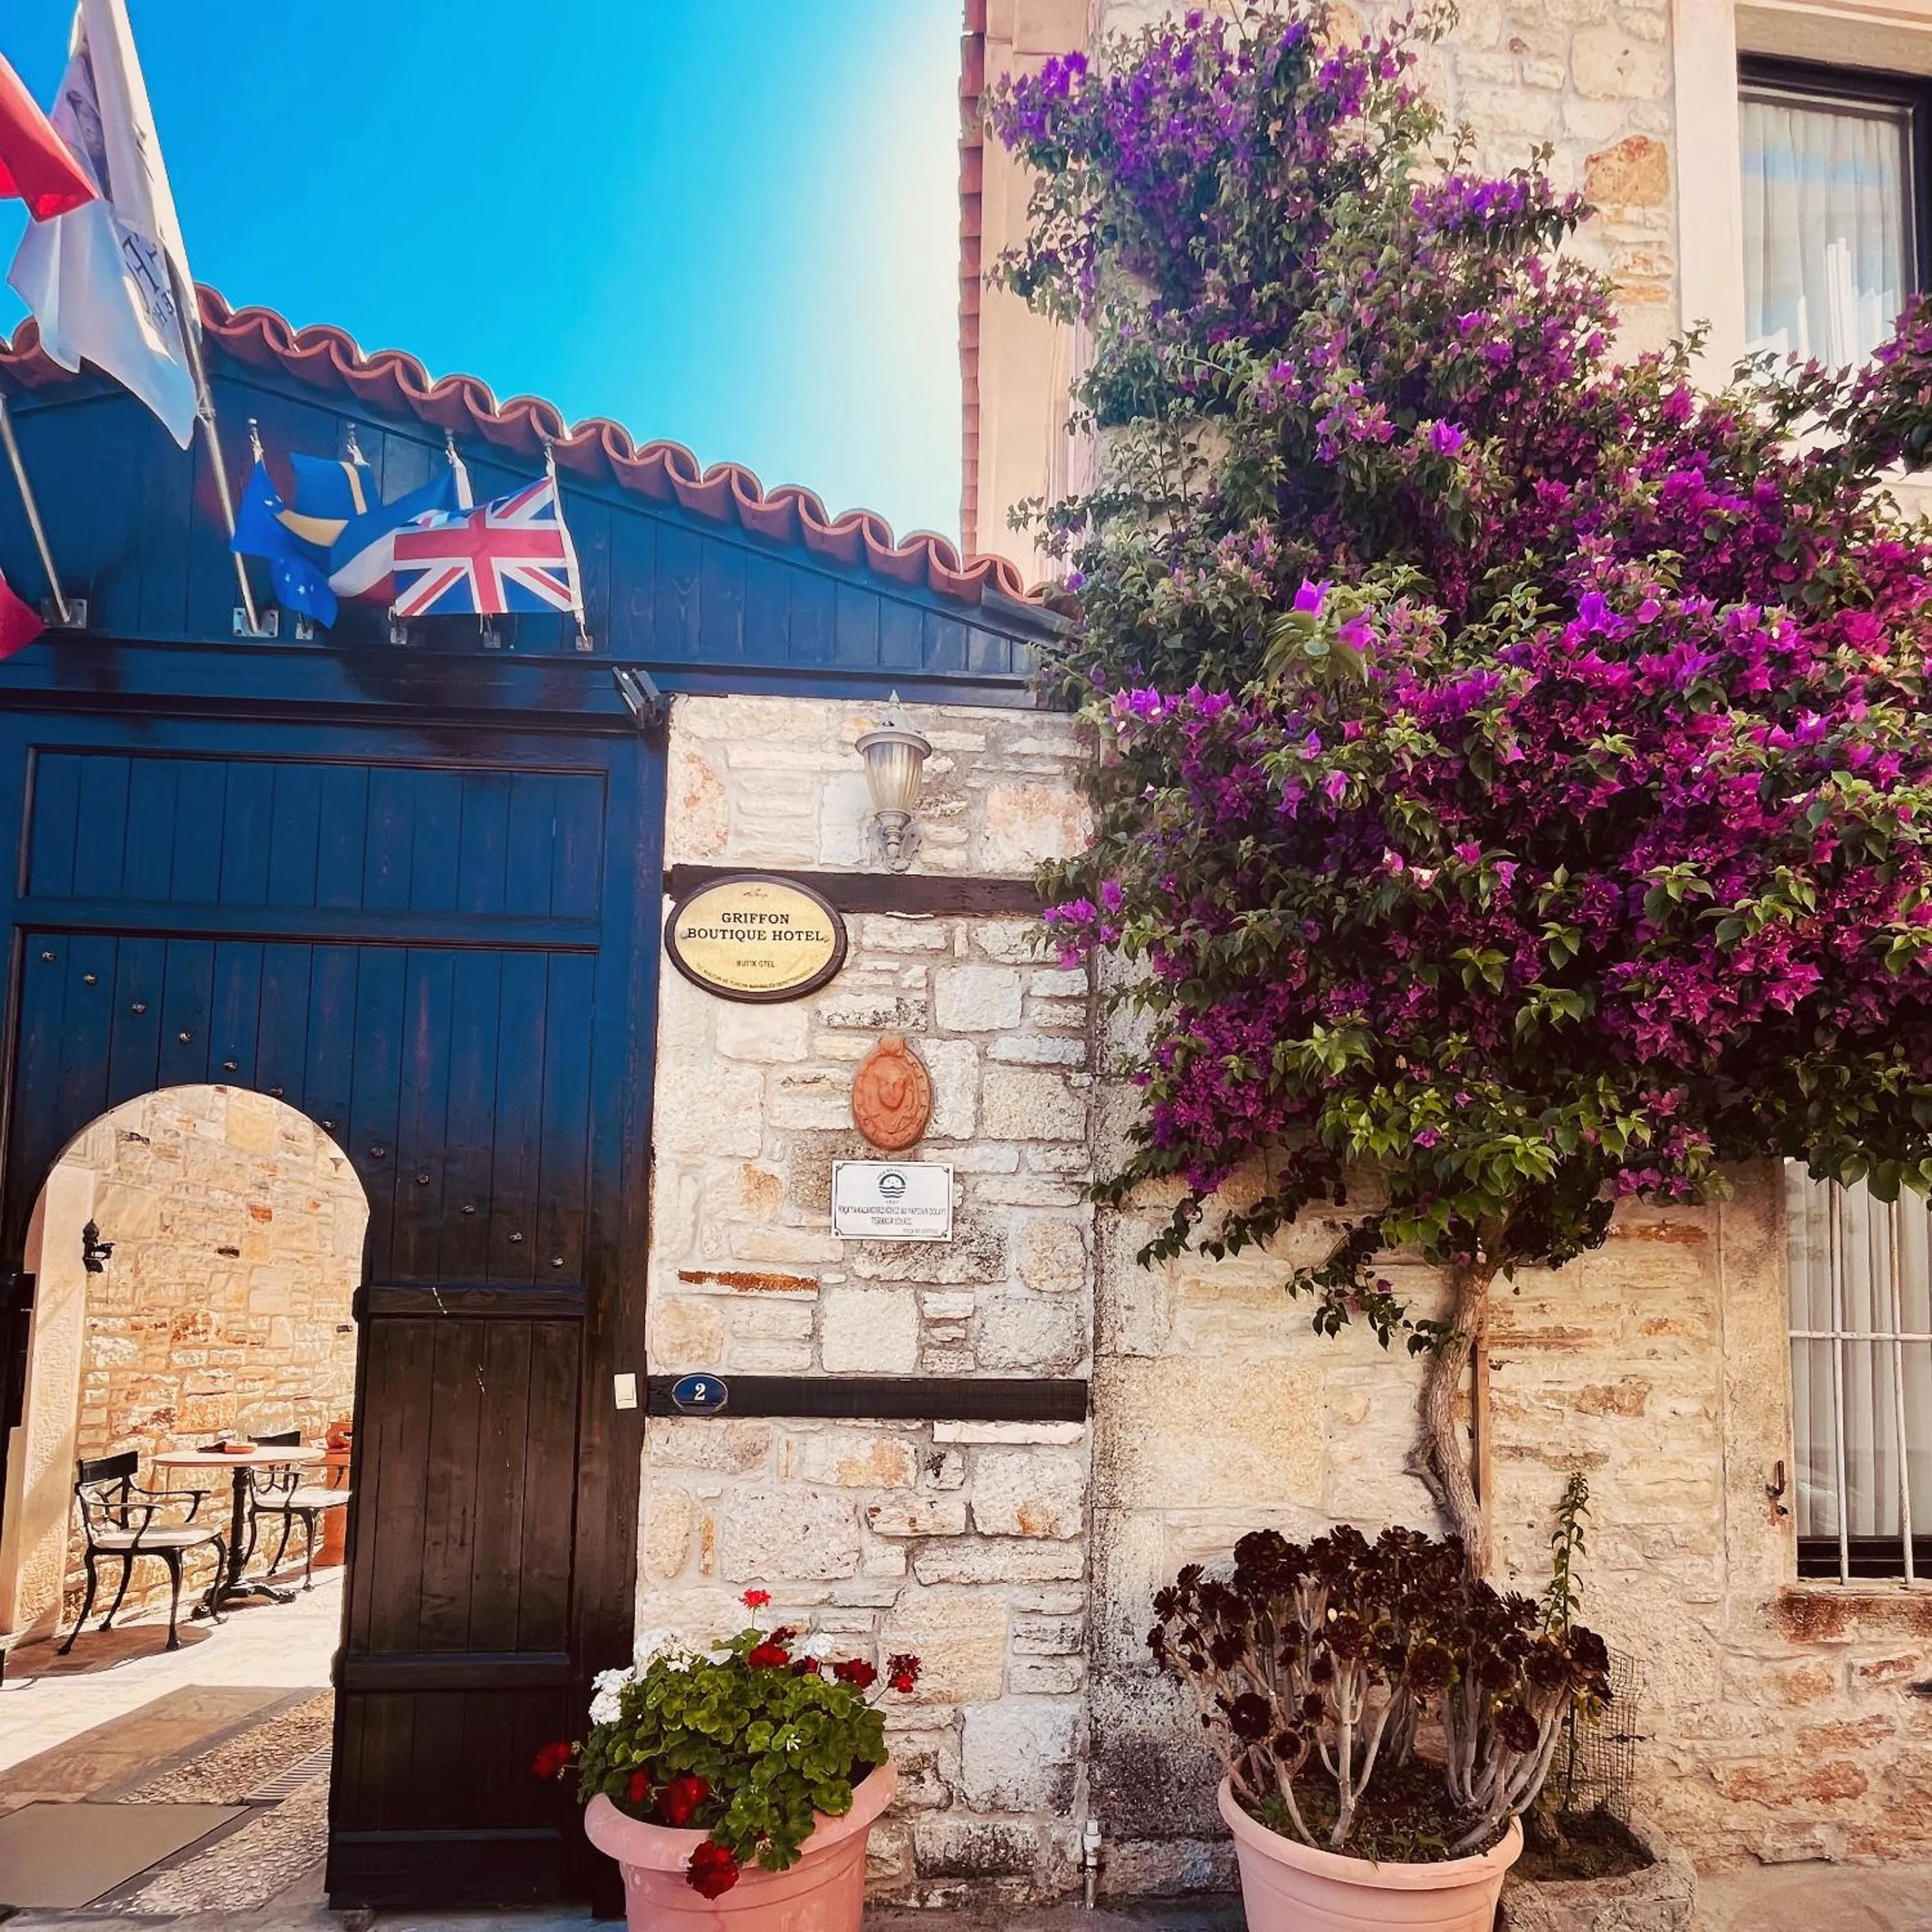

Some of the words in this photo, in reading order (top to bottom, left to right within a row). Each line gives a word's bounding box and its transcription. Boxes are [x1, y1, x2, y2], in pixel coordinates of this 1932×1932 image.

[722, 913, 789, 925] GRIFFON
[687, 928, 767, 943] BOUTIQUE
[772, 930, 824, 942] HOTEL
[694, 1383, 706, 1401] 2
